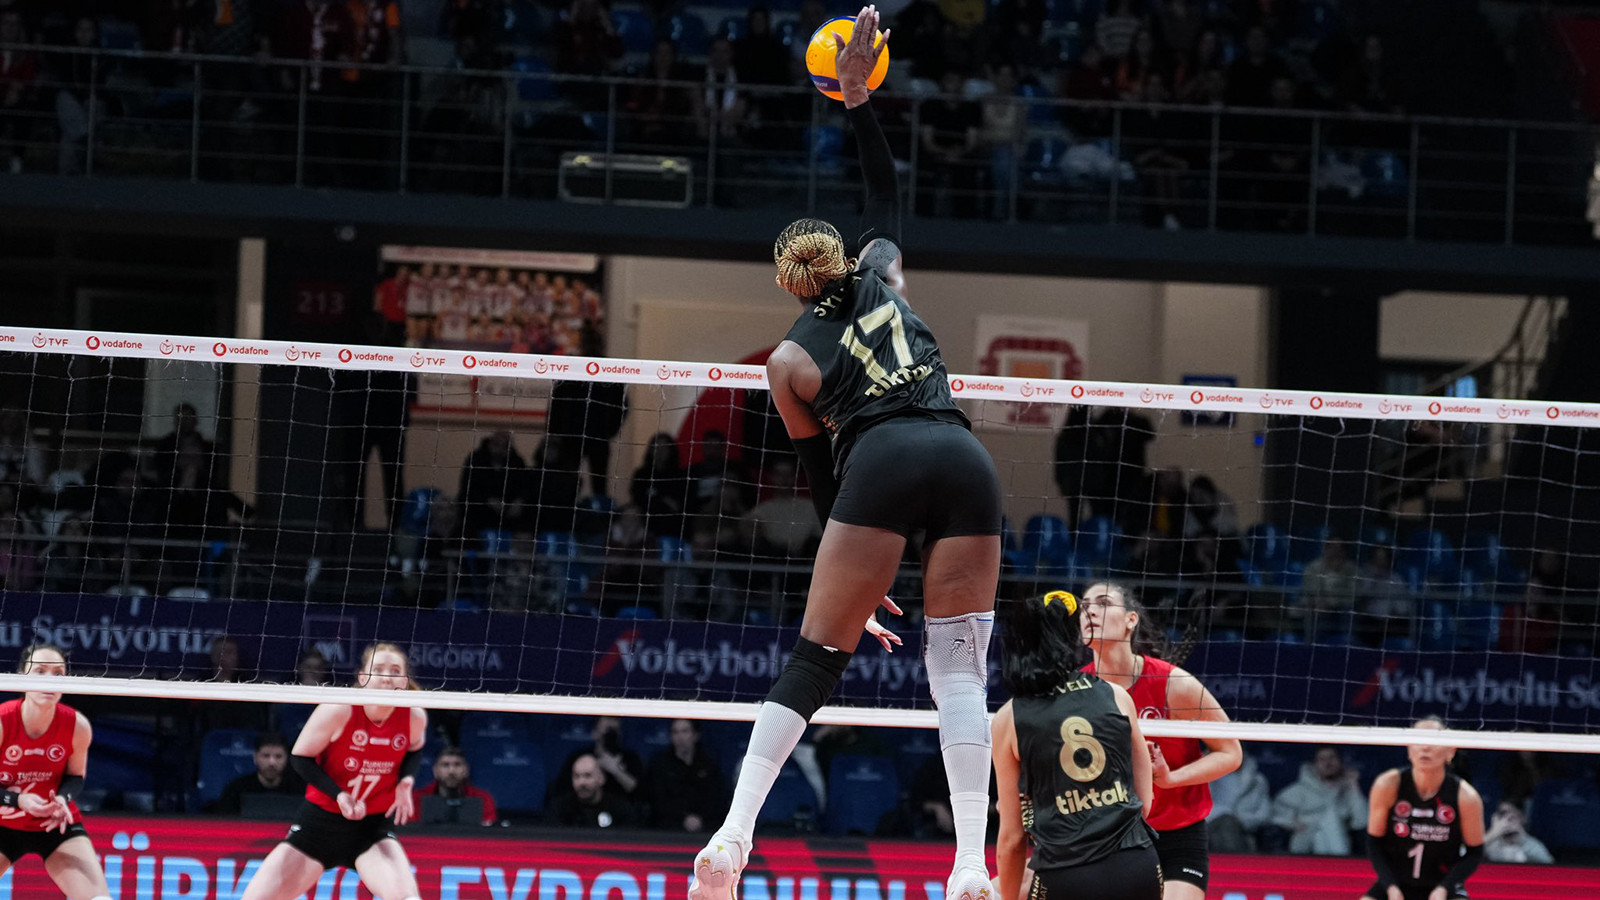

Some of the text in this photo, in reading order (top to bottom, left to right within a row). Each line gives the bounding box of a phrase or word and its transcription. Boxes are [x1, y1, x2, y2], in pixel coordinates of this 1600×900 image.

[297, 291, 344, 314] 213
[839, 301, 913, 384] 17
[48, 338, 69, 347] TVF
[102, 339, 143, 350] vodafone
[176, 344, 196, 354] TVF
[228, 346, 269, 356] vodafone
[301, 351, 321, 360] TVF
[353, 352, 394, 362] vodafone
[425, 358, 446, 367] TVF
[477, 359, 518, 369] vodafone
[550, 364, 570, 373] TVF
[601, 365, 641, 375] vodafone
[673, 370, 692, 379] TVF
[723, 370, 763, 381] vodafone
[966, 382, 1005, 392] vodafone
[1036, 387, 1055, 396] TVF
[1086, 388, 1125, 398] vodafone
[1155, 393, 1174, 402] TVF
[1205, 394, 1244, 404] vodafone
[1275, 398, 1294, 407] TVF
[1325, 400, 1363, 410] vodafone
[1393, 403, 1413, 412] TVF
[1443, 404, 1482, 414] vodafone
[1512, 408, 1531, 417] TVF
[1561, 408, 1600, 419] vodafone
[1376, 667, 1560, 711] Voleybolu
[1060, 716, 1106, 782] 8
[346, 774, 382, 801] 17
[1056, 780, 1130, 815] tiktak
[1407, 843, 1425, 879] 1
